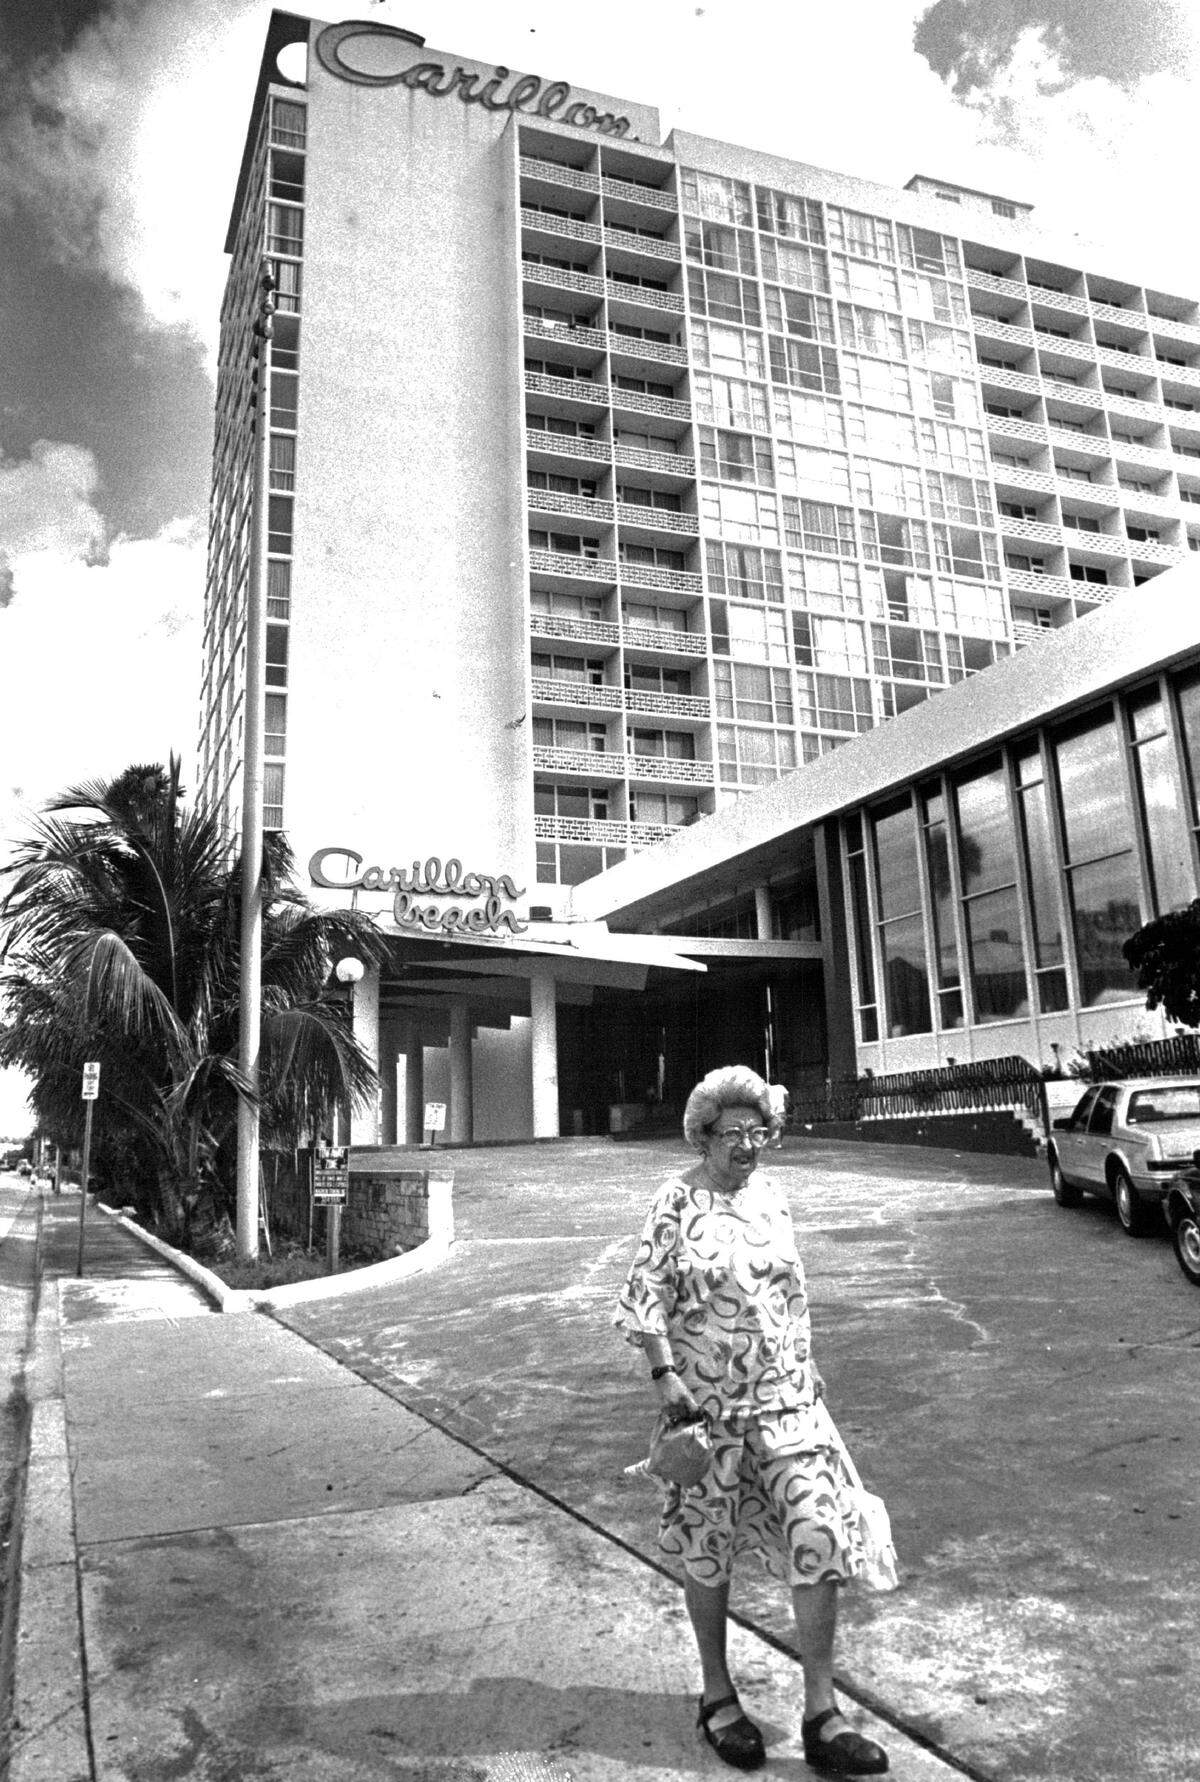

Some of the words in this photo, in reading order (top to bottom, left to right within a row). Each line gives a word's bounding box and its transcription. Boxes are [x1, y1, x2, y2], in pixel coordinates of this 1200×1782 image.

[315, 20, 639, 142] Carillon
[308, 847, 526, 899] Carillon
[394, 891, 528, 933] beach
